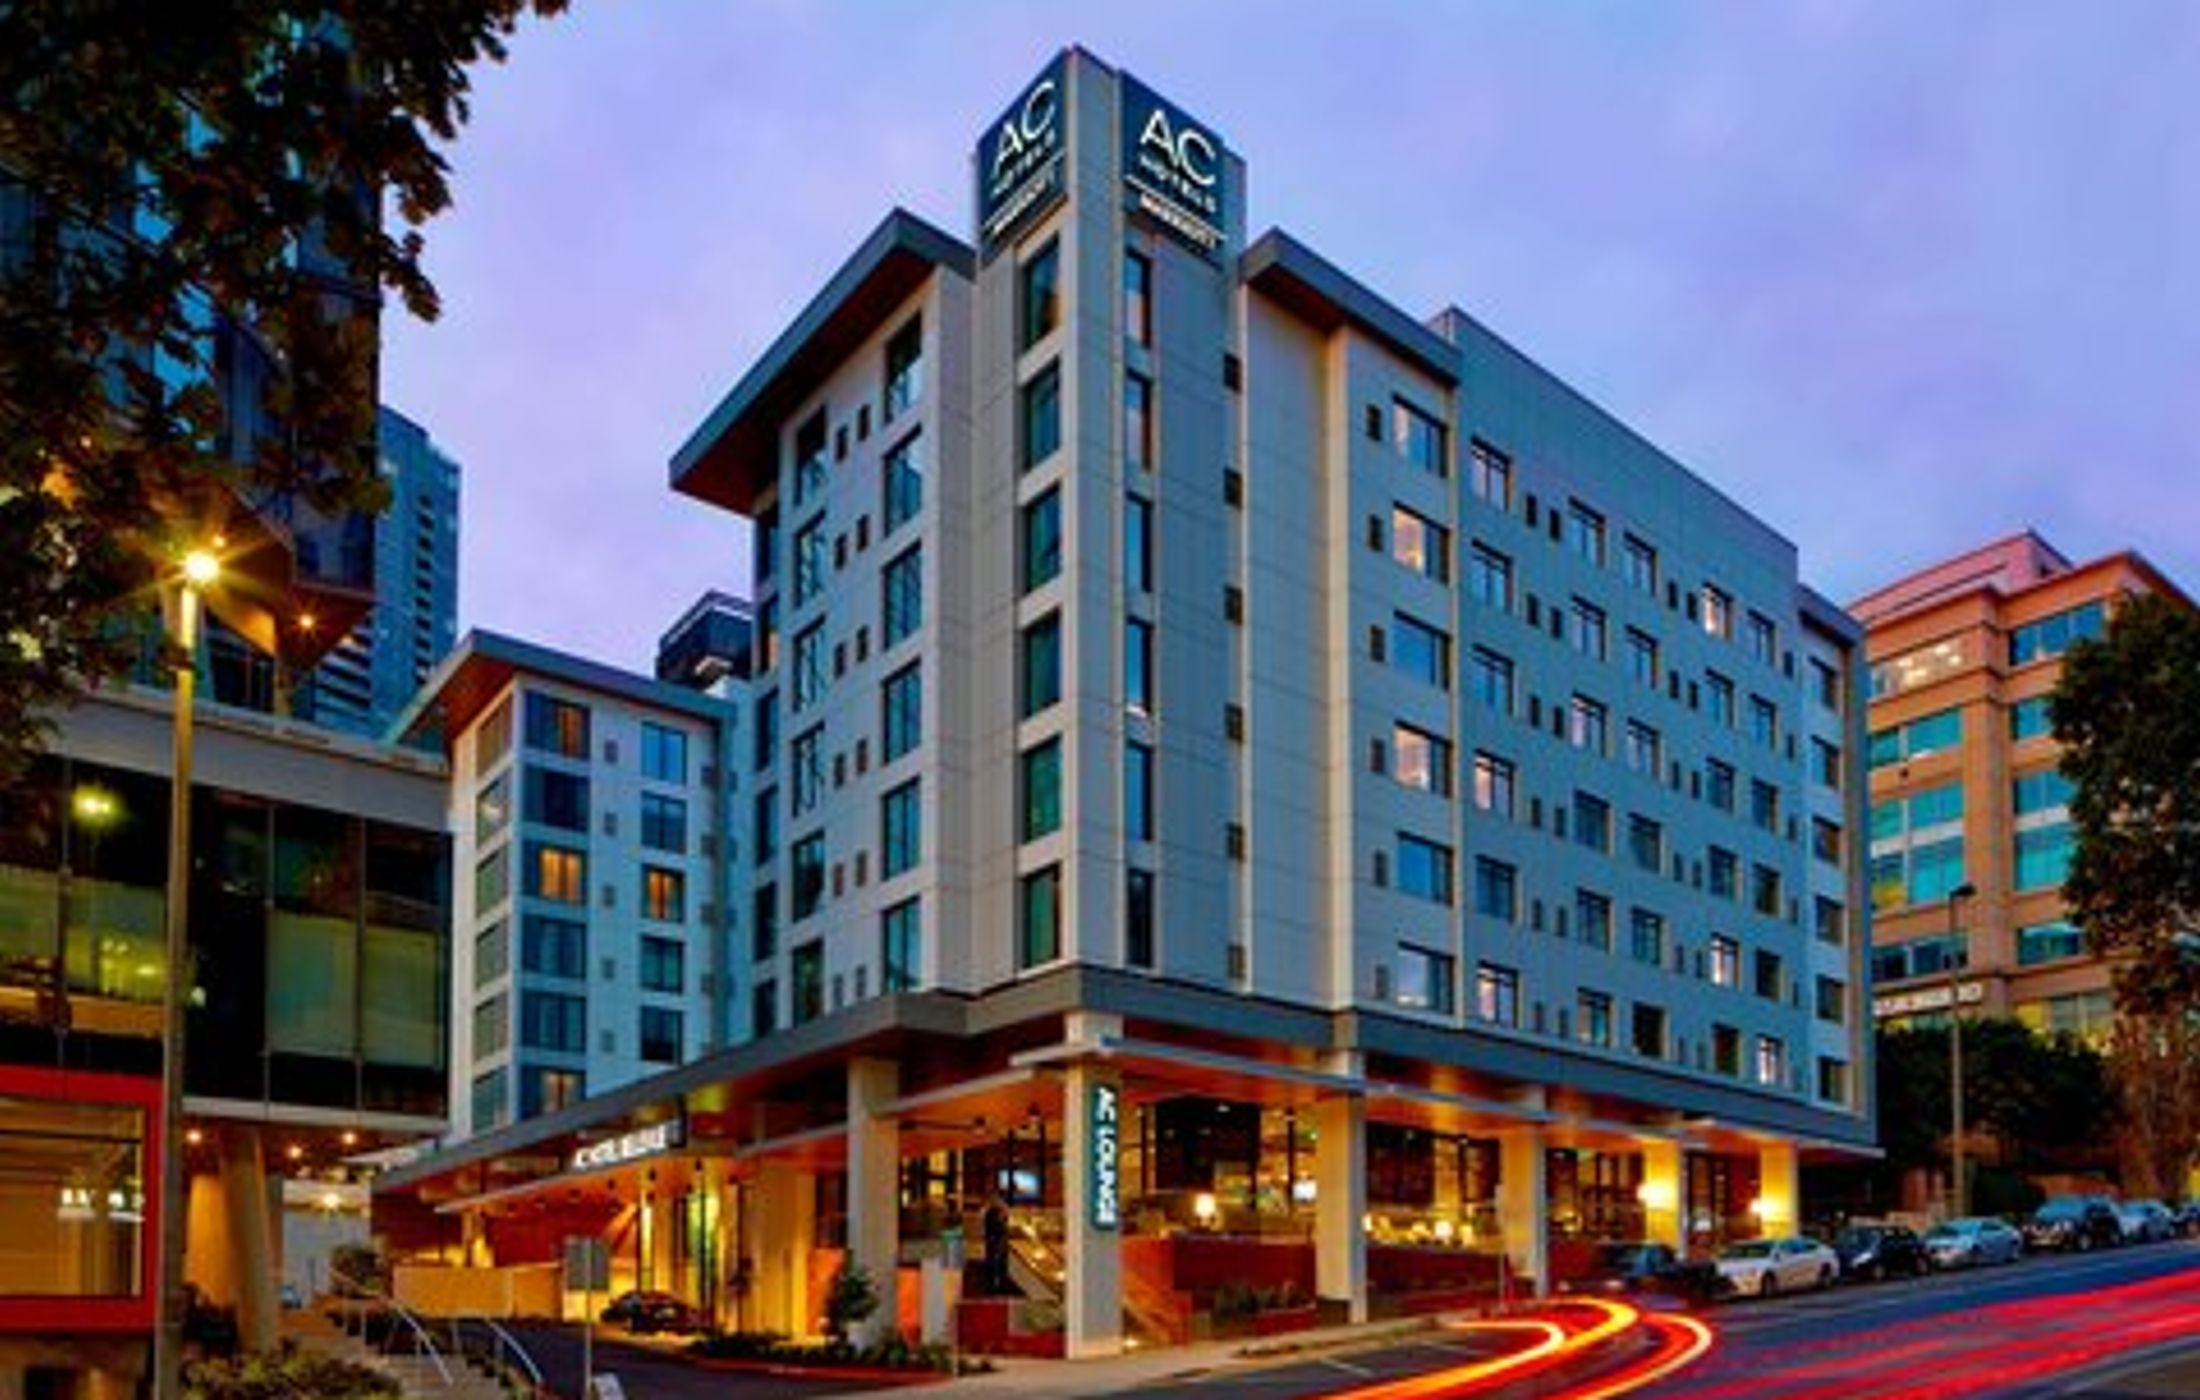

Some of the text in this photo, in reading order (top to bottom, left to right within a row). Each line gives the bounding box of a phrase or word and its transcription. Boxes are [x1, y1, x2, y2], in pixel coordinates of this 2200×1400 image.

[993, 80, 1056, 178] AC
[1139, 109, 1216, 186] AC
[1095, 1086, 1117, 1224] AC LOUNGE
